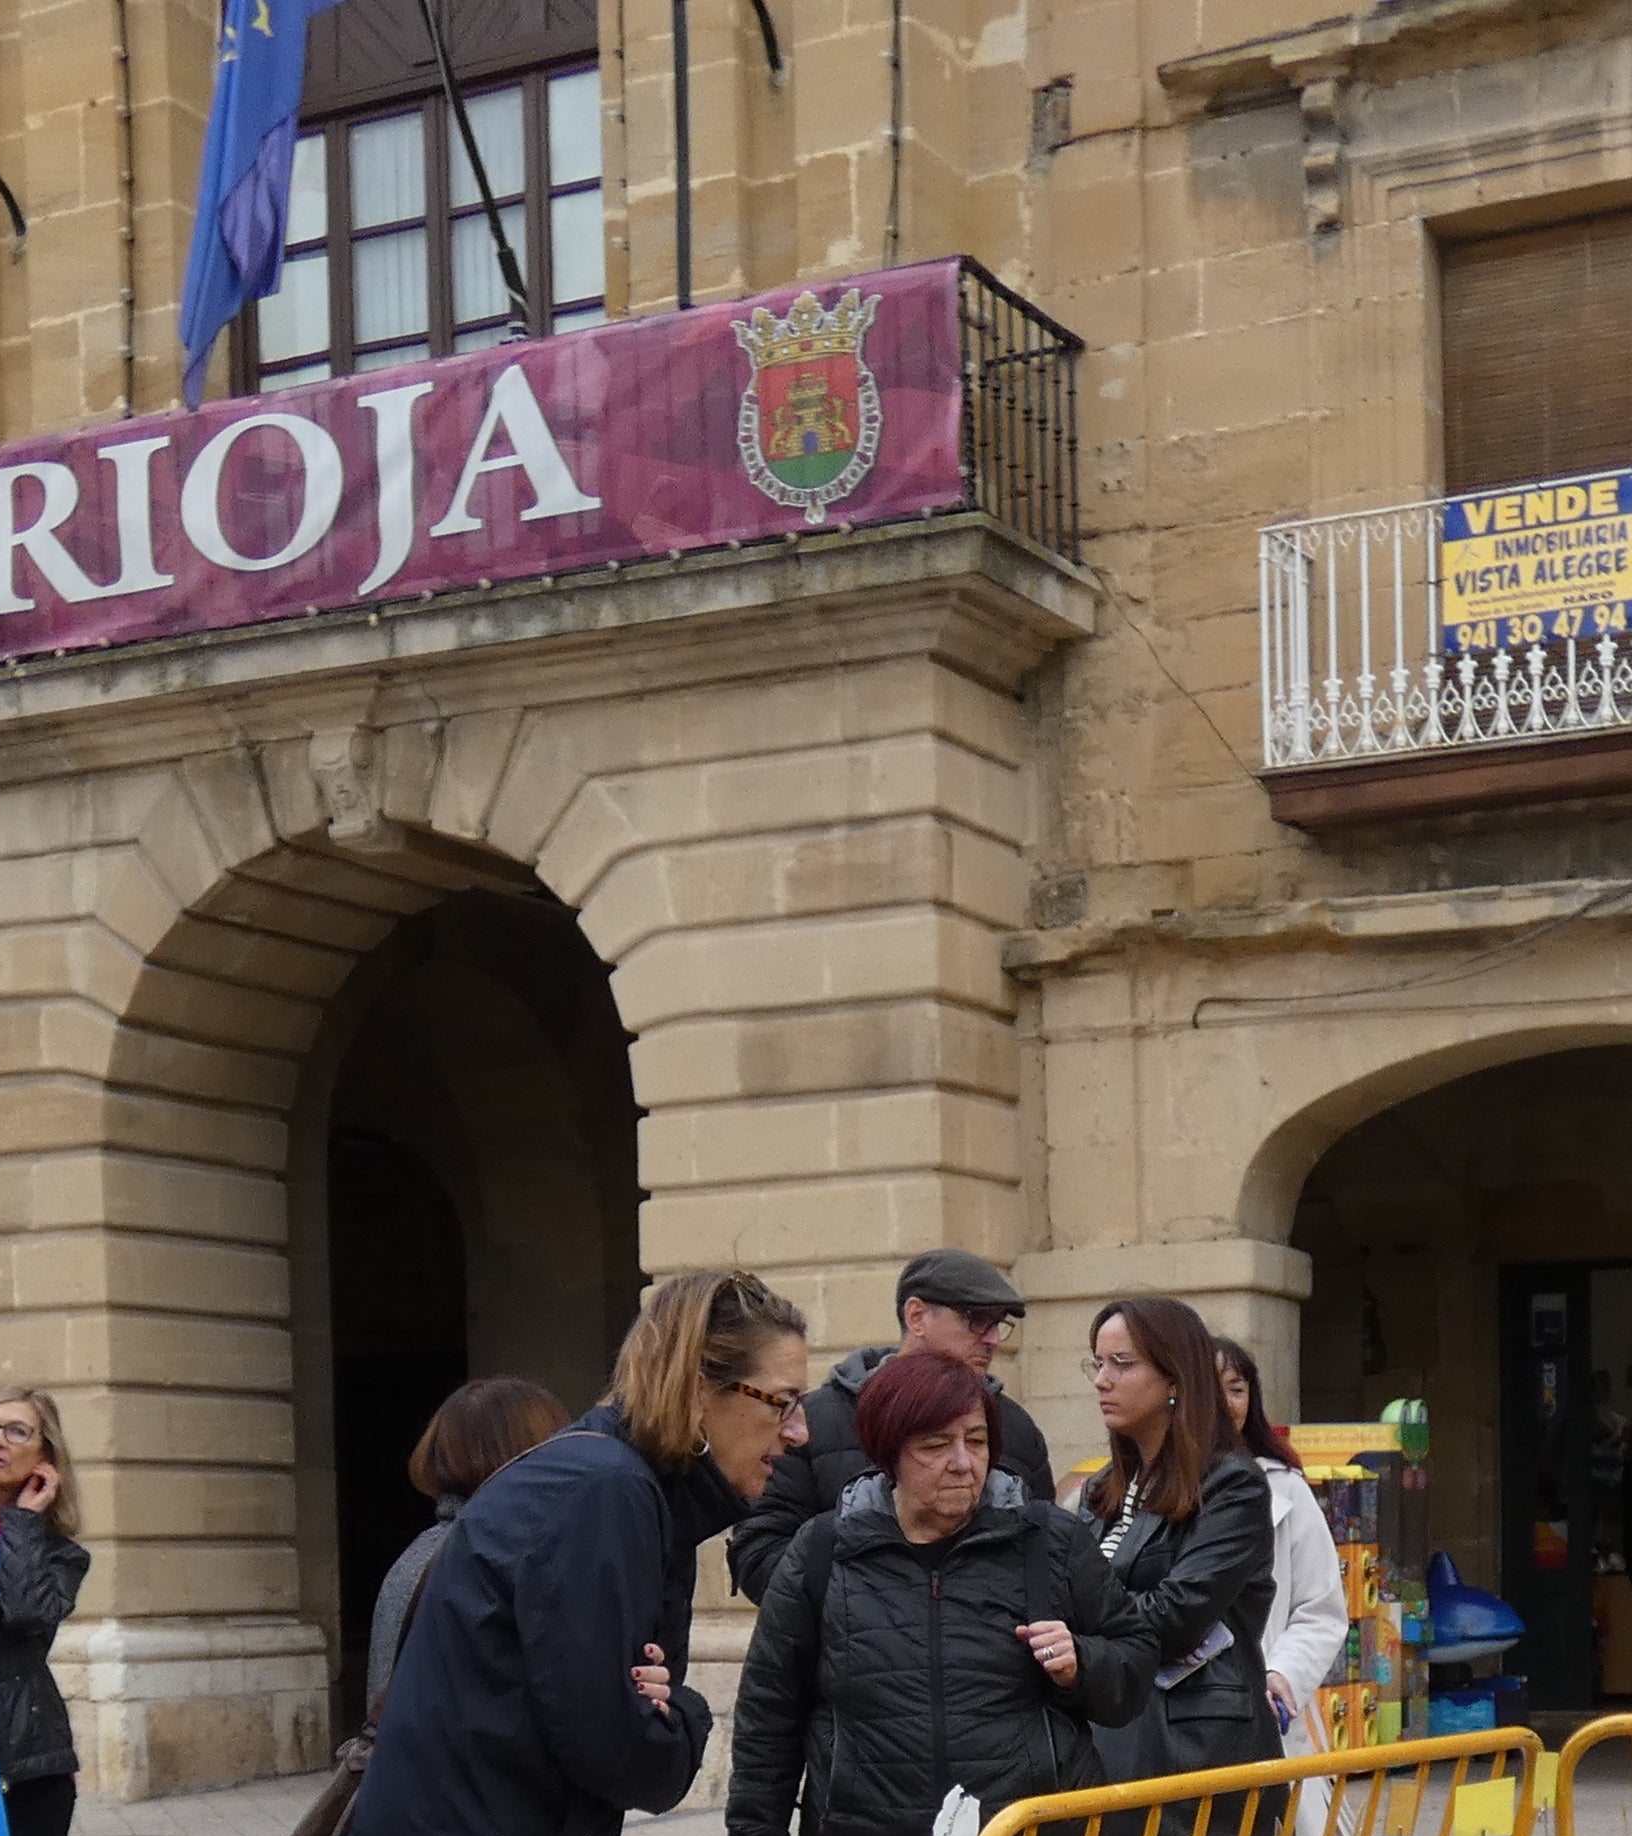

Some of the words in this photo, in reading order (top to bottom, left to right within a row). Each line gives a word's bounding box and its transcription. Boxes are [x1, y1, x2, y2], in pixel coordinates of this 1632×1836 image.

[1462, 479, 1619, 535] VENDE
[1495, 520, 1629, 561] INMOBILIARIA
[1455, 563, 1521, 596] VISTA
[1534, 548, 1628, 586] ALEGRE
[1456, 619, 1497, 652] 941
[1507, 613, 1543, 646] 30
[1553, 607, 1584, 640] 47
[1593, 602, 1626, 638] 94
